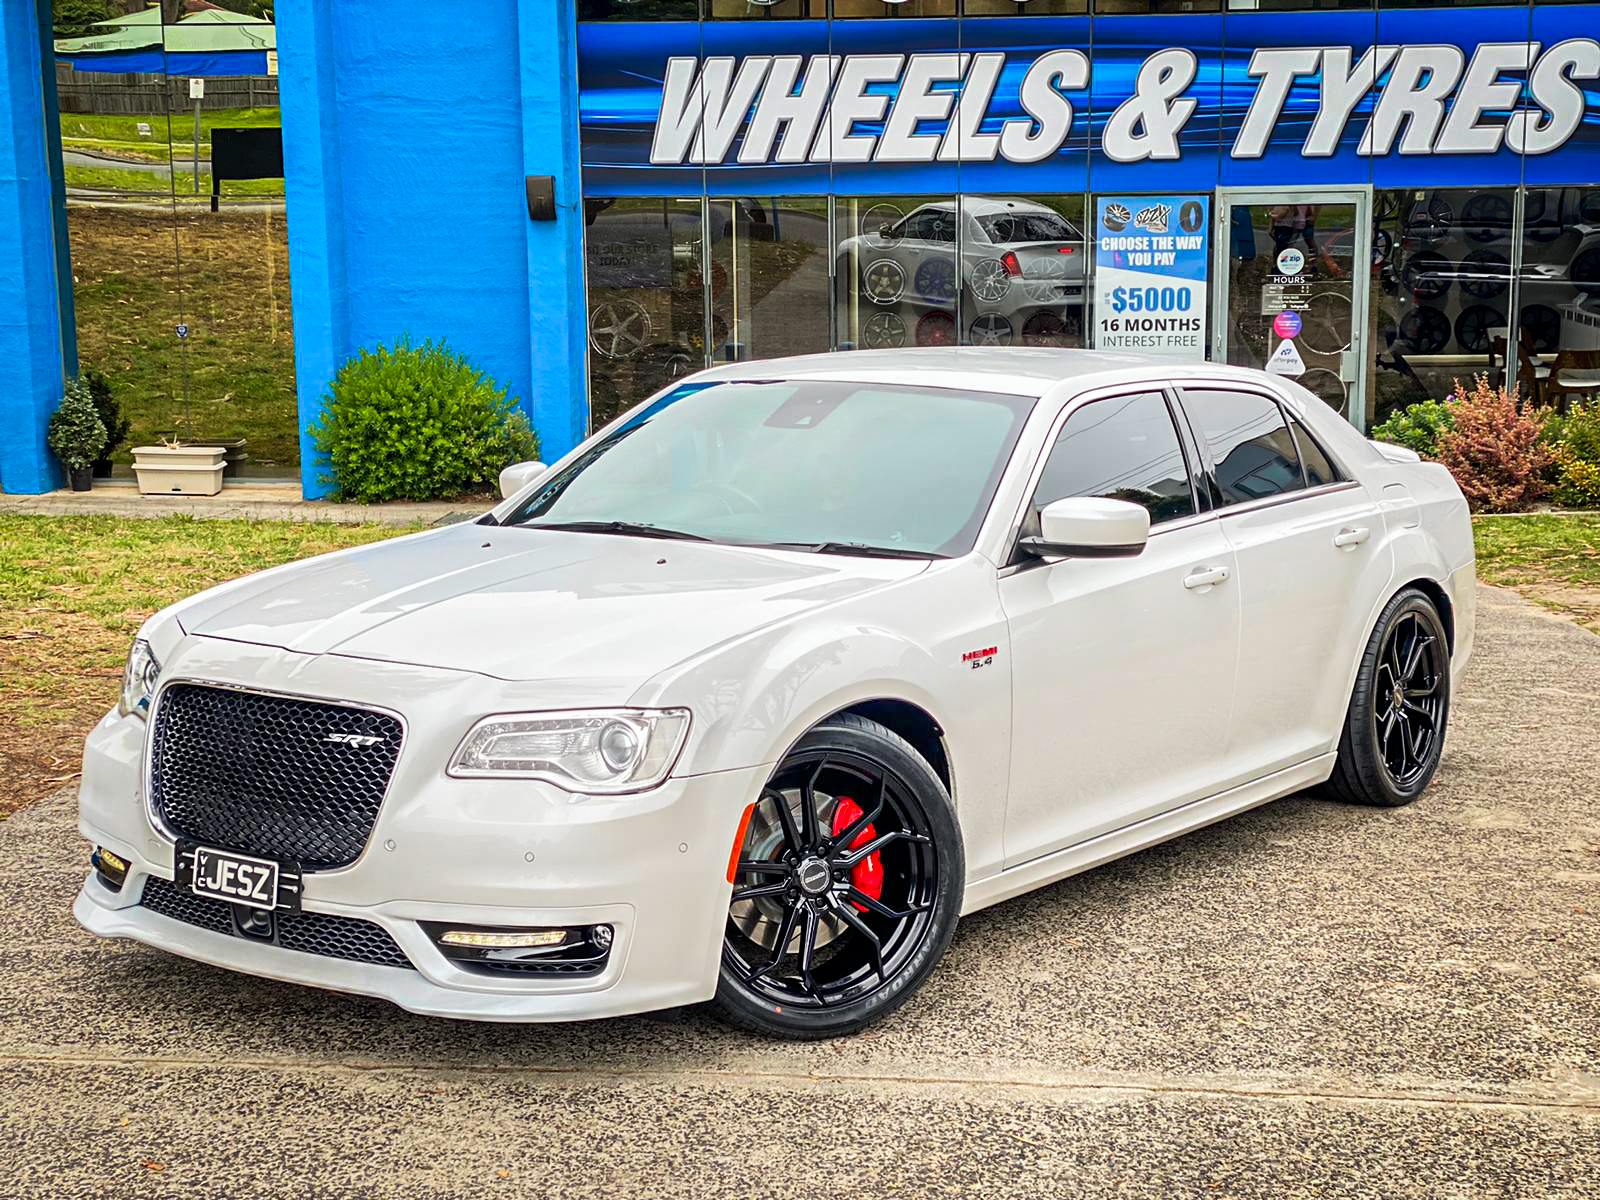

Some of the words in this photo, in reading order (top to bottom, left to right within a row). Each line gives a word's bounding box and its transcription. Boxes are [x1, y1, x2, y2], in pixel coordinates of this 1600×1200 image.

[650, 49, 1089, 163] WHEELS
[1101, 47, 1197, 162] &
[1231, 38, 1600, 158] TYRES
[1101, 236, 1149, 250] CHOOSE
[1151, 236, 1174, 250] THE
[1176, 236, 1203, 250] WAY
[1127, 252, 1152, 266] YOU
[1154, 252, 1176, 266] PAY
[1273, 276, 1305, 284] HOURS
[1112, 286, 1191, 314] $5000
[1101, 319, 1119, 332] 16
[1125, 318, 1201, 332] MONTHS
[1103, 336, 1163, 347] INTEREST
[1167, 335, 1197, 347] FREE
[962, 646, 998, 662] HEMI
[323, 733, 385, 748] SRT
[198, 855, 208, 887] VIC
[206, 860, 270, 901] JESZ
